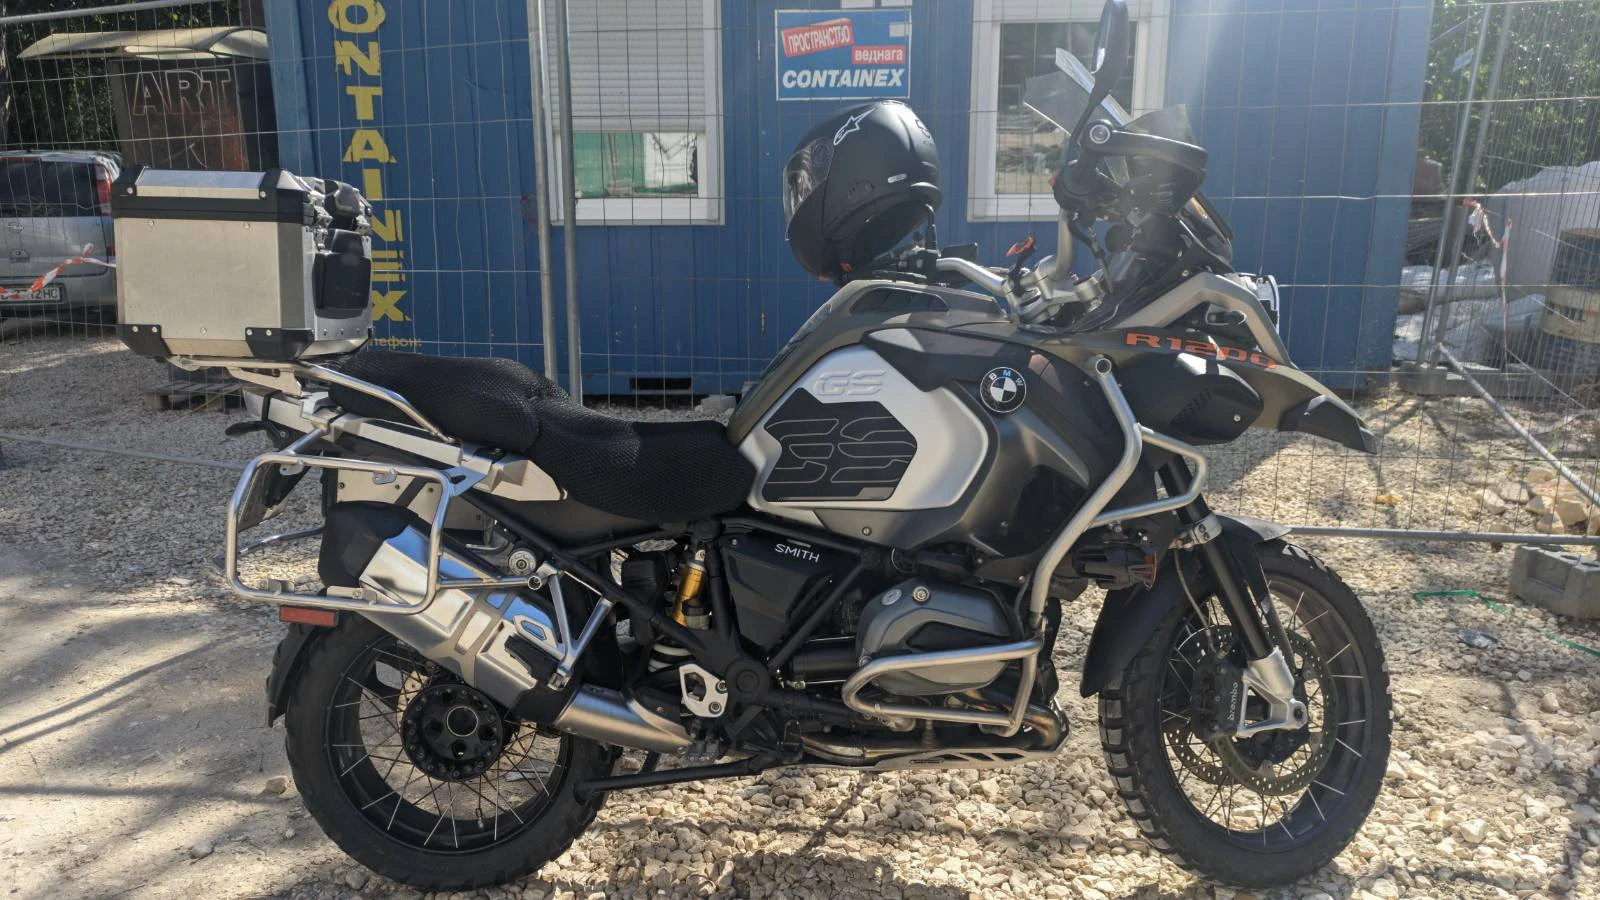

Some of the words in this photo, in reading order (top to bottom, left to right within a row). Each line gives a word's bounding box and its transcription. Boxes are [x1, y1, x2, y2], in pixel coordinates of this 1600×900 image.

[855, 49, 904, 63] веднага
[782, 68, 905, 88] CONTAINEX
[132, 69, 231, 116] ART
[328, 0, 412, 321] ONTAINEX
[1126, 332, 1277, 369] R1200
[813, 370, 887, 396] GS
[989, 369, 1024, 386] BMW
[774, 543, 820, 563] SMITH
[1227, 682, 1239, 721] brembo
